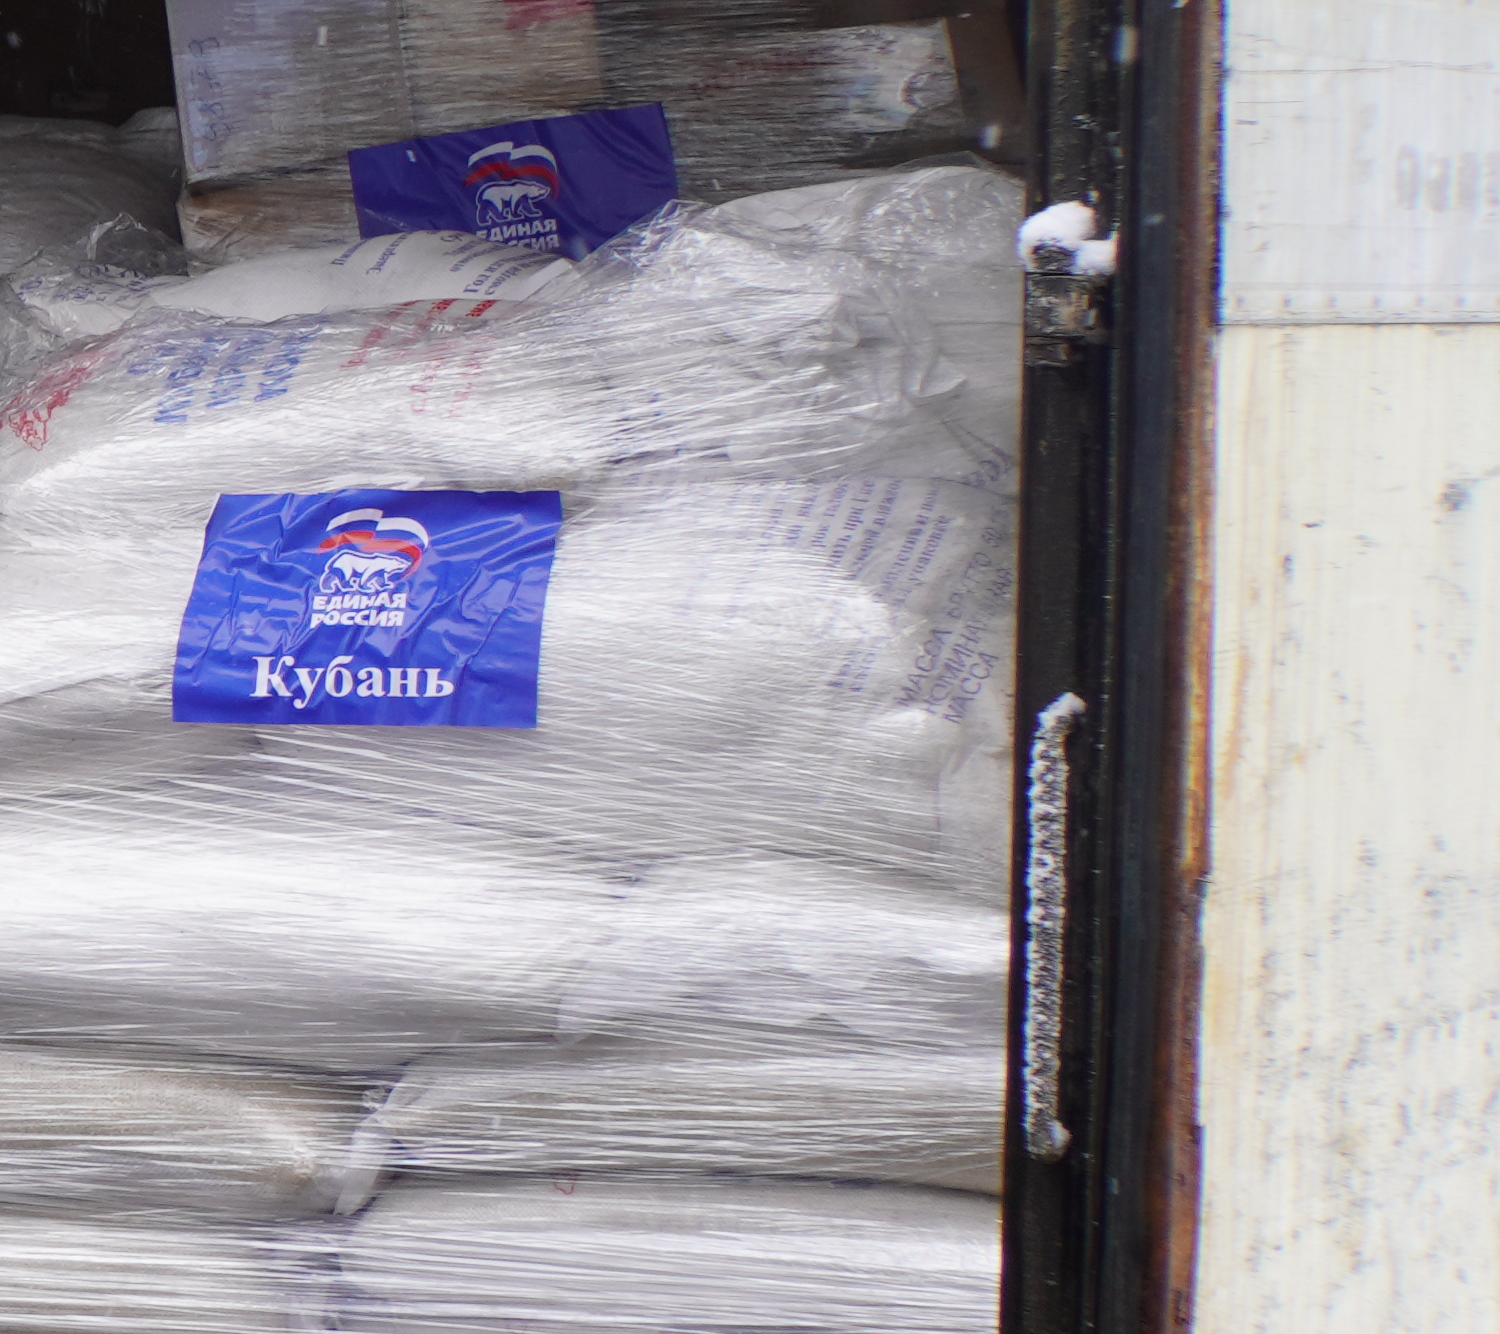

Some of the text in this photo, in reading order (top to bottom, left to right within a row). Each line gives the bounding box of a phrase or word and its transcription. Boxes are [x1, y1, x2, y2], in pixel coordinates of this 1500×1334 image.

[476, 219, 557, 242] ЕДИНАЯ
[313, 591, 407, 611] ЕДИНАЯ
[309, 609, 406, 629] РОССИЯ
[249, 655, 455, 709] Кубань
